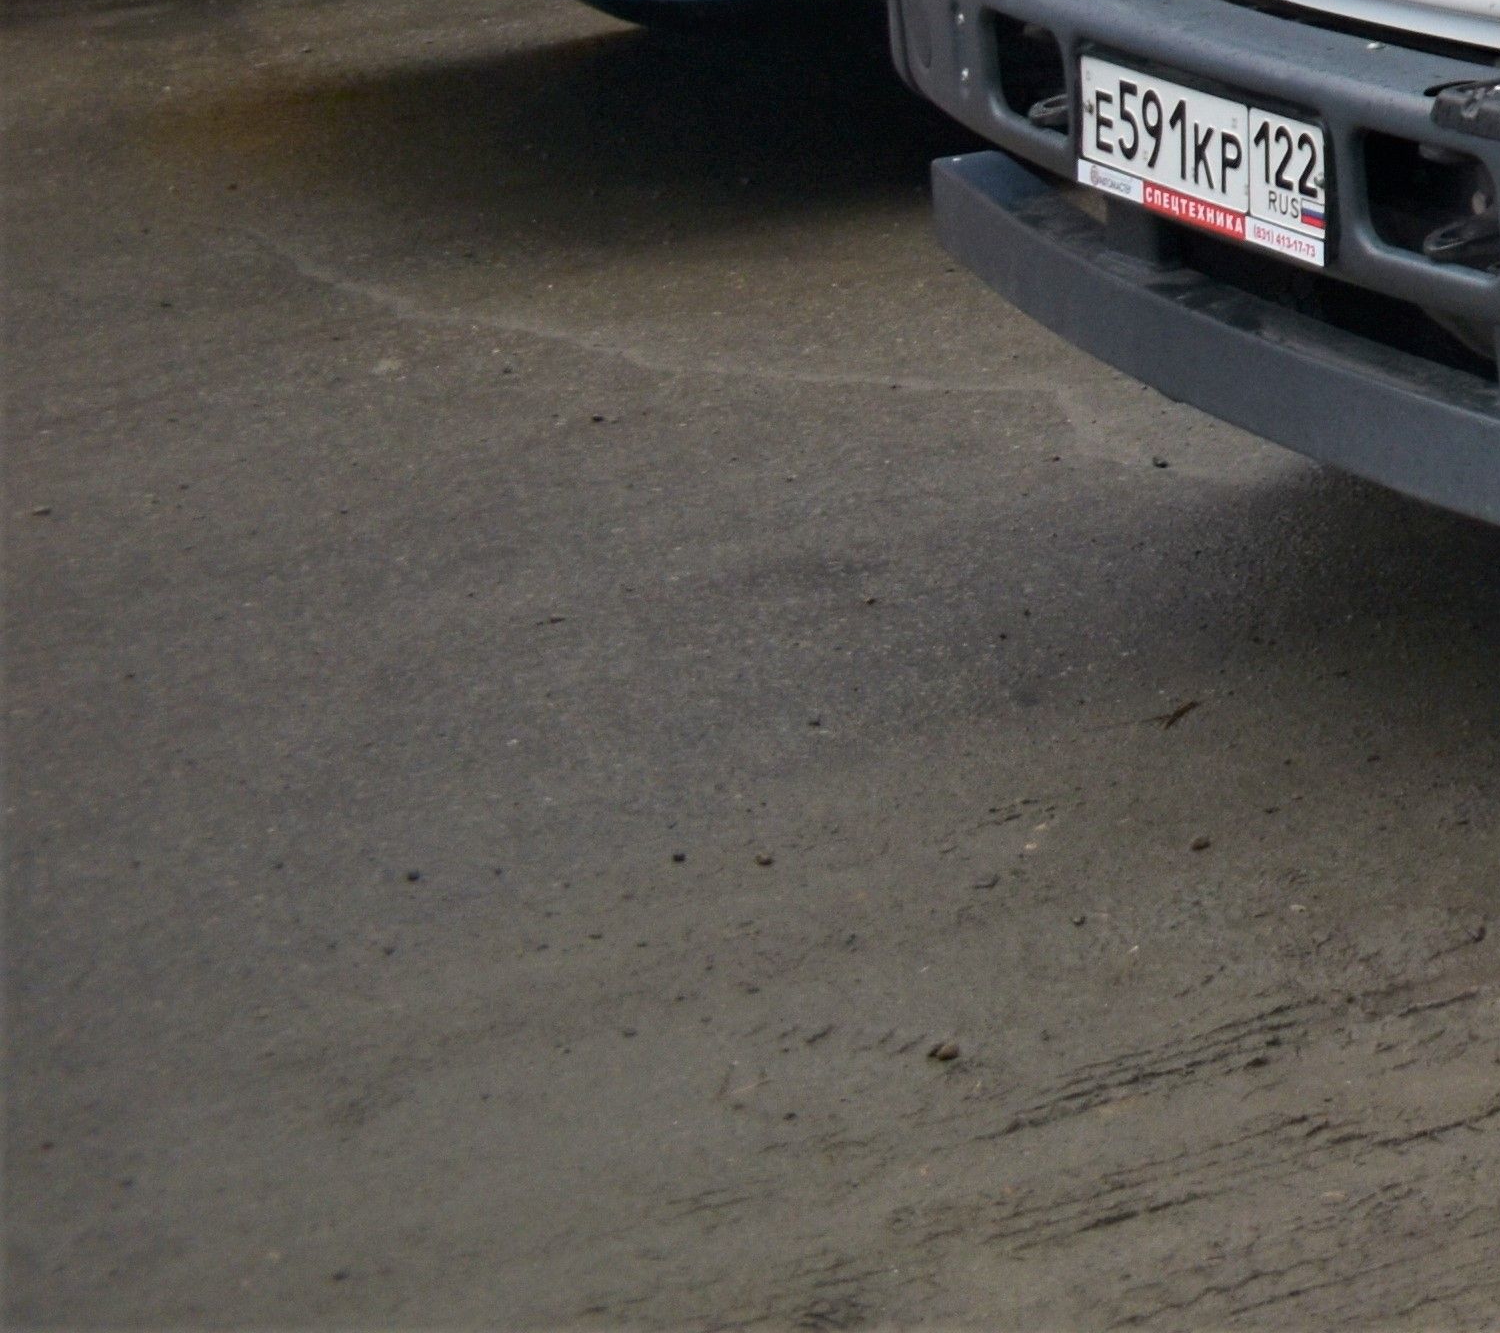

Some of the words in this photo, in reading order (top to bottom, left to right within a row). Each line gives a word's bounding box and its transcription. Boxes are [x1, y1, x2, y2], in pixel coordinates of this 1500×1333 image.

[1253, 121, 1318, 199] 122
[1145, 186, 1243, 235] СПЕЦТЕХНИКА
[1268, 190, 1299, 219] RUS
